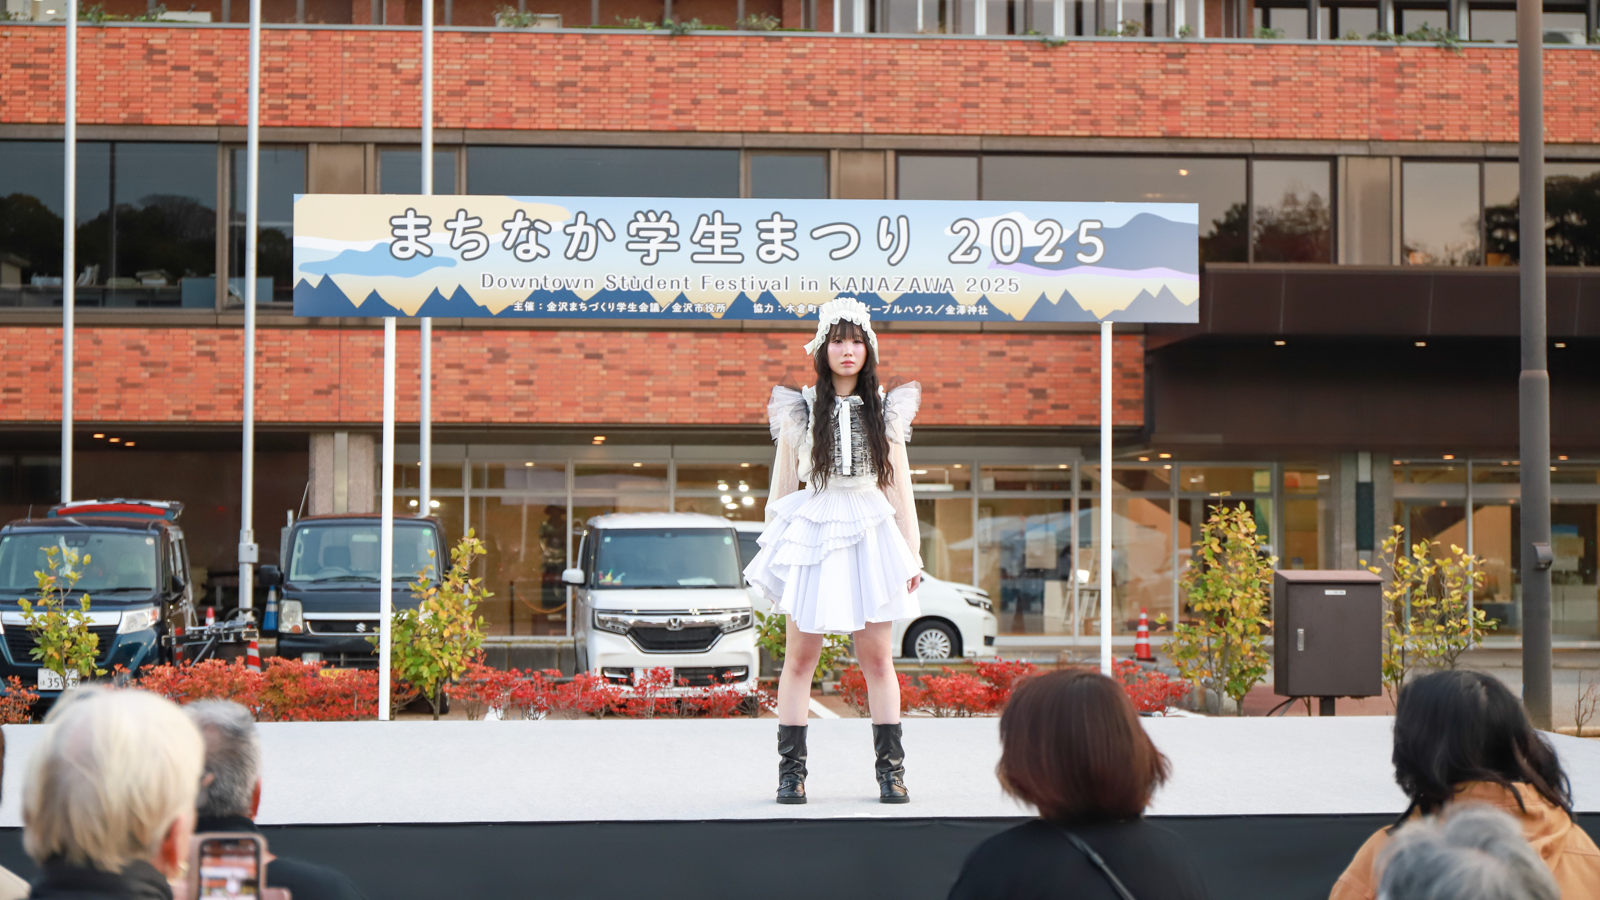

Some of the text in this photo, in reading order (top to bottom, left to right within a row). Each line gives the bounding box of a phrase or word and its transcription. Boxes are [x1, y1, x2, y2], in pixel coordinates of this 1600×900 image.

[389, 207, 1105, 266] まちなか学生まつり 2025
[480, 272, 1021, 294] Downtown Student Festival in KANAZAWA 2025
